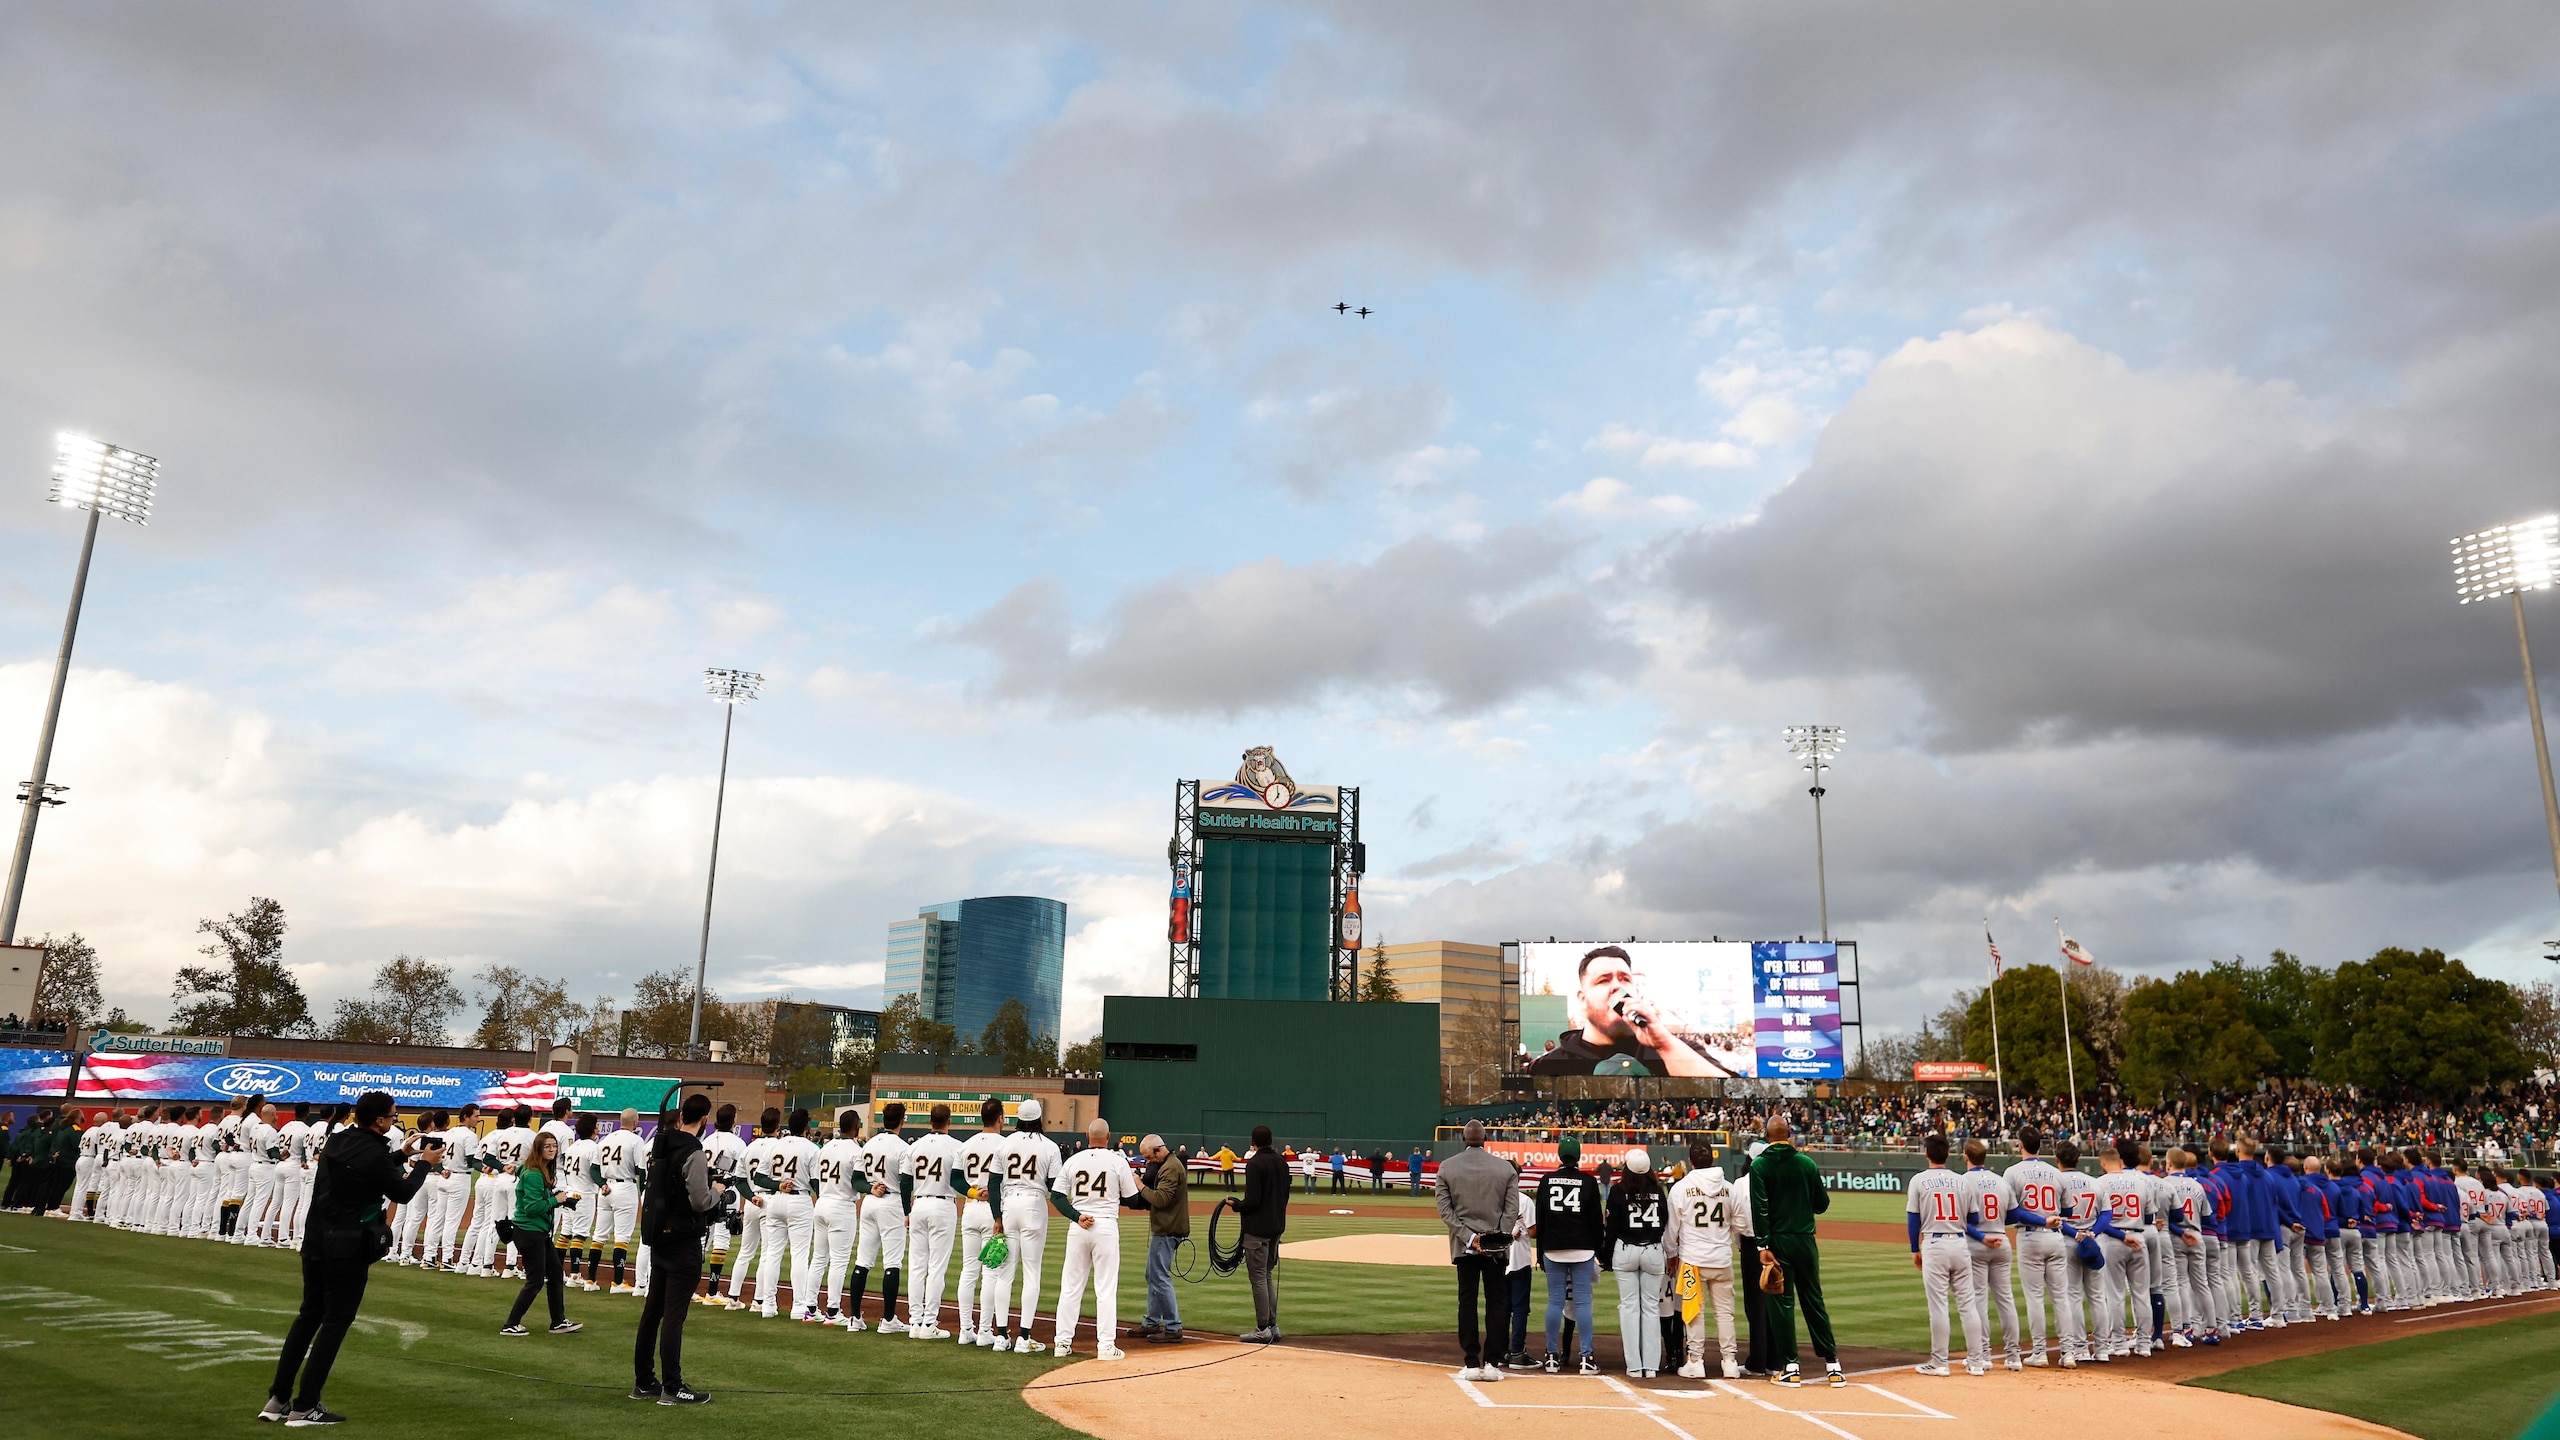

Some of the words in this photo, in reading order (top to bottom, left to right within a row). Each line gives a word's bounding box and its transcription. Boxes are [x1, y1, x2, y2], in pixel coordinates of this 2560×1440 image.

[1199, 812, 1249, 828] Sutter
[1250, 814, 1300, 831] Health
[1302, 816, 1337, 832] Park
[1764, 960, 1783, 973] O'ER
[1784, 960, 1800, 973] THE
[1801, 960, 1824, 973] LAND
[1770, 978, 1782, 990] OF
[1782, 978, 1799, 991] THE
[1800, 978, 1820, 991] FREE
[1765, 995, 1784, 1008] AND
[1784, 995, 1801, 1008] THE
[1802, 996, 1827, 1008] HOME
[1782, 1013, 1794, 1026] OF
[1795, 1013, 1811, 1026] THE
[116, 1036, 169, 1051] Sutter
[170, 1038, 223, 1054] Health
[1783, 1030, 1812, 1043] BRAVE
[313, 1070, 339, 1082] Your
[342, 1072, 392, 1084] California
[395, 1074, 419, 1085] Ford
[422, 1074, 461, 1086] Dealers
[1919, 1065, 1944, 1073] HOME
[222, 1067, 283, 1092] Ford
[558, 1086, 574, 1096] YET
[81, 1137, 91, 1150] 24
[131, 1132, 143, 1146] 24
[156, 1135, 168, 1149] 24
[193, 1136, 204, 1150] 24
[279, 1134, 293, 1150] 24
[1121, 1136, 1137, 1144] 403
[500, 1142, 522, 1161] 24
[602, 1145, 622, 1166] 24
[1488, 1146, 1518, 1161] lean
[565, 1156, 580, 1176] 24
[749, 1158, 760, 1180] 2
[772, 1154, 798, 1178] 24
[820, 1159, 841, 1184] 24
[864, 1153, 886, 1178] 24
[915, 1156, 942, 1182] 24
[967, 1153, 994, 1178] 24
[1008, 1153, 1037, 1180] 24
[1076, 1170, 1106, 1197] 24
[1837, 1172, 1901, 1190] Health
[1921, 1177, 1964, 1191] COUNSELL
[1978, 1179, 1996, 1190] HAPP
[2023, 1170, 2054, 1182] TUCKER
[2108, 1181, 2135, 1190] BUSCH
[1550, 1186, 1581, 1212] 24
[1933, 1192, 1960, 1221] 11
[2024, 1183, 2056, 1212] 30
[2110, 1193, 2140, 1219] 29
[1628, 1202, 1660, 1228] 24
[1694, 1202, 1724, 1228] 24
[1984, 1193, 1999, 1221] 8
[2182, 1197, 2194, 1221] 4
[676, 1391, 694, 1400] HOKA
